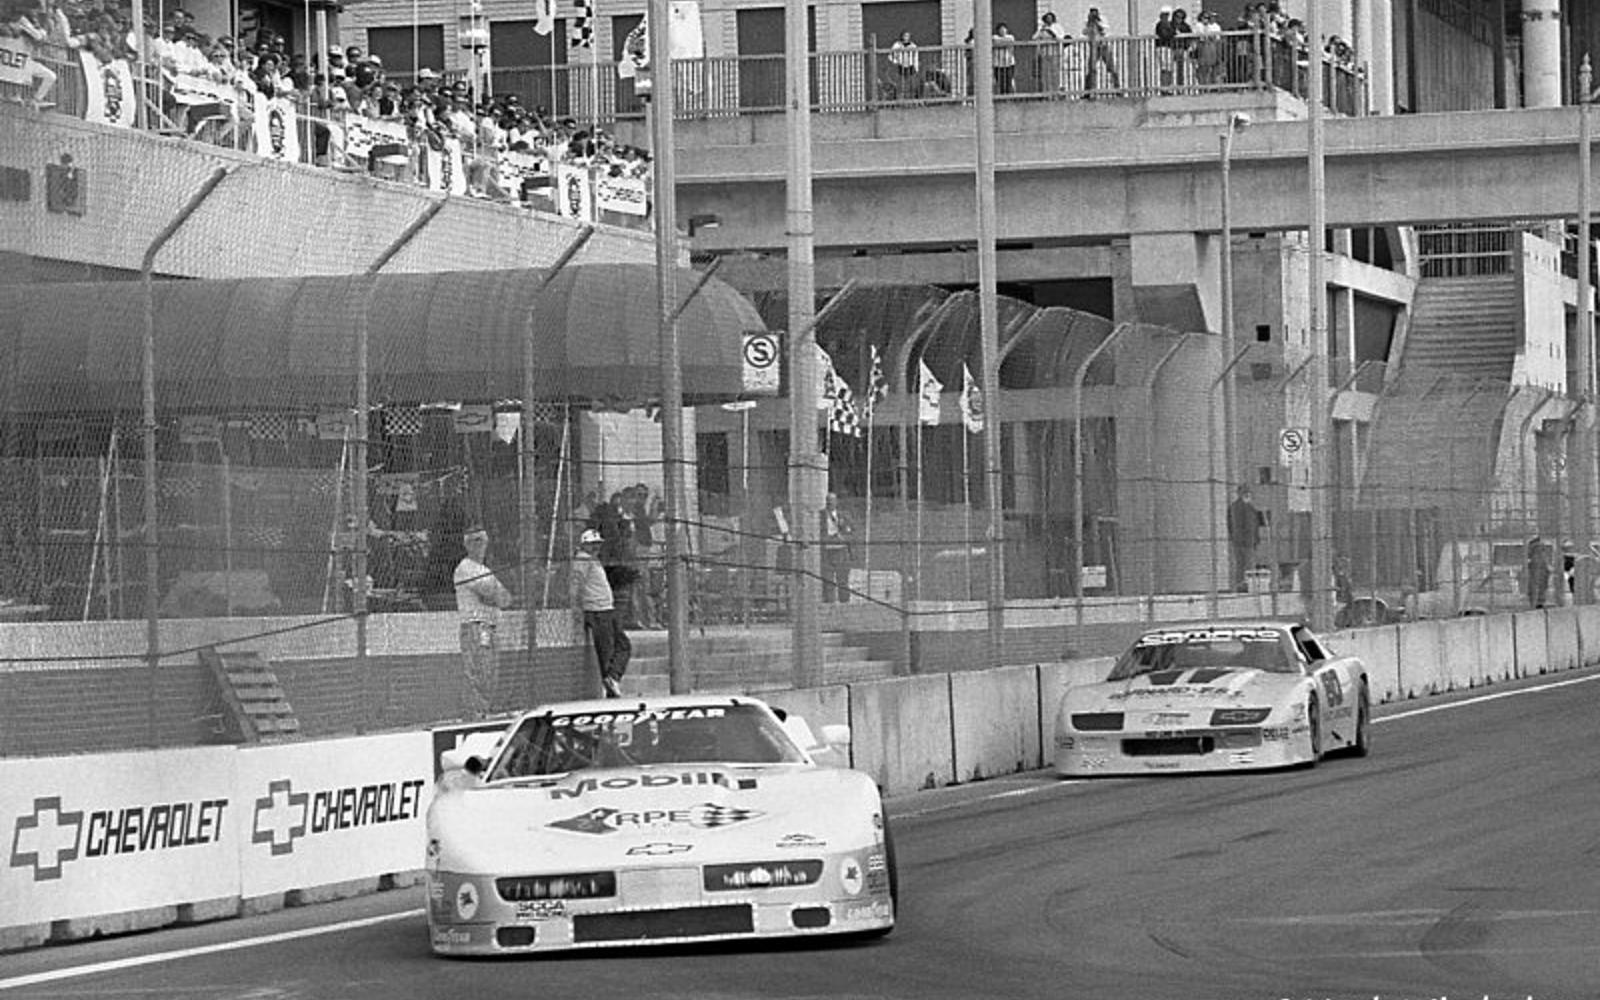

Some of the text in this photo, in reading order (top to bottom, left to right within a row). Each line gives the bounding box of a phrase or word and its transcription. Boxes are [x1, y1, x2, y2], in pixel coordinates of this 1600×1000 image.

[0, 47, 28, 69] OLET
[551, 708, 726, 727] GOODYEAR
[551, 772, 708, 799] Mobil
[311, 780, 425, 833] CHEVROLET
[85, 799, 229, 857] CHEVROLET
